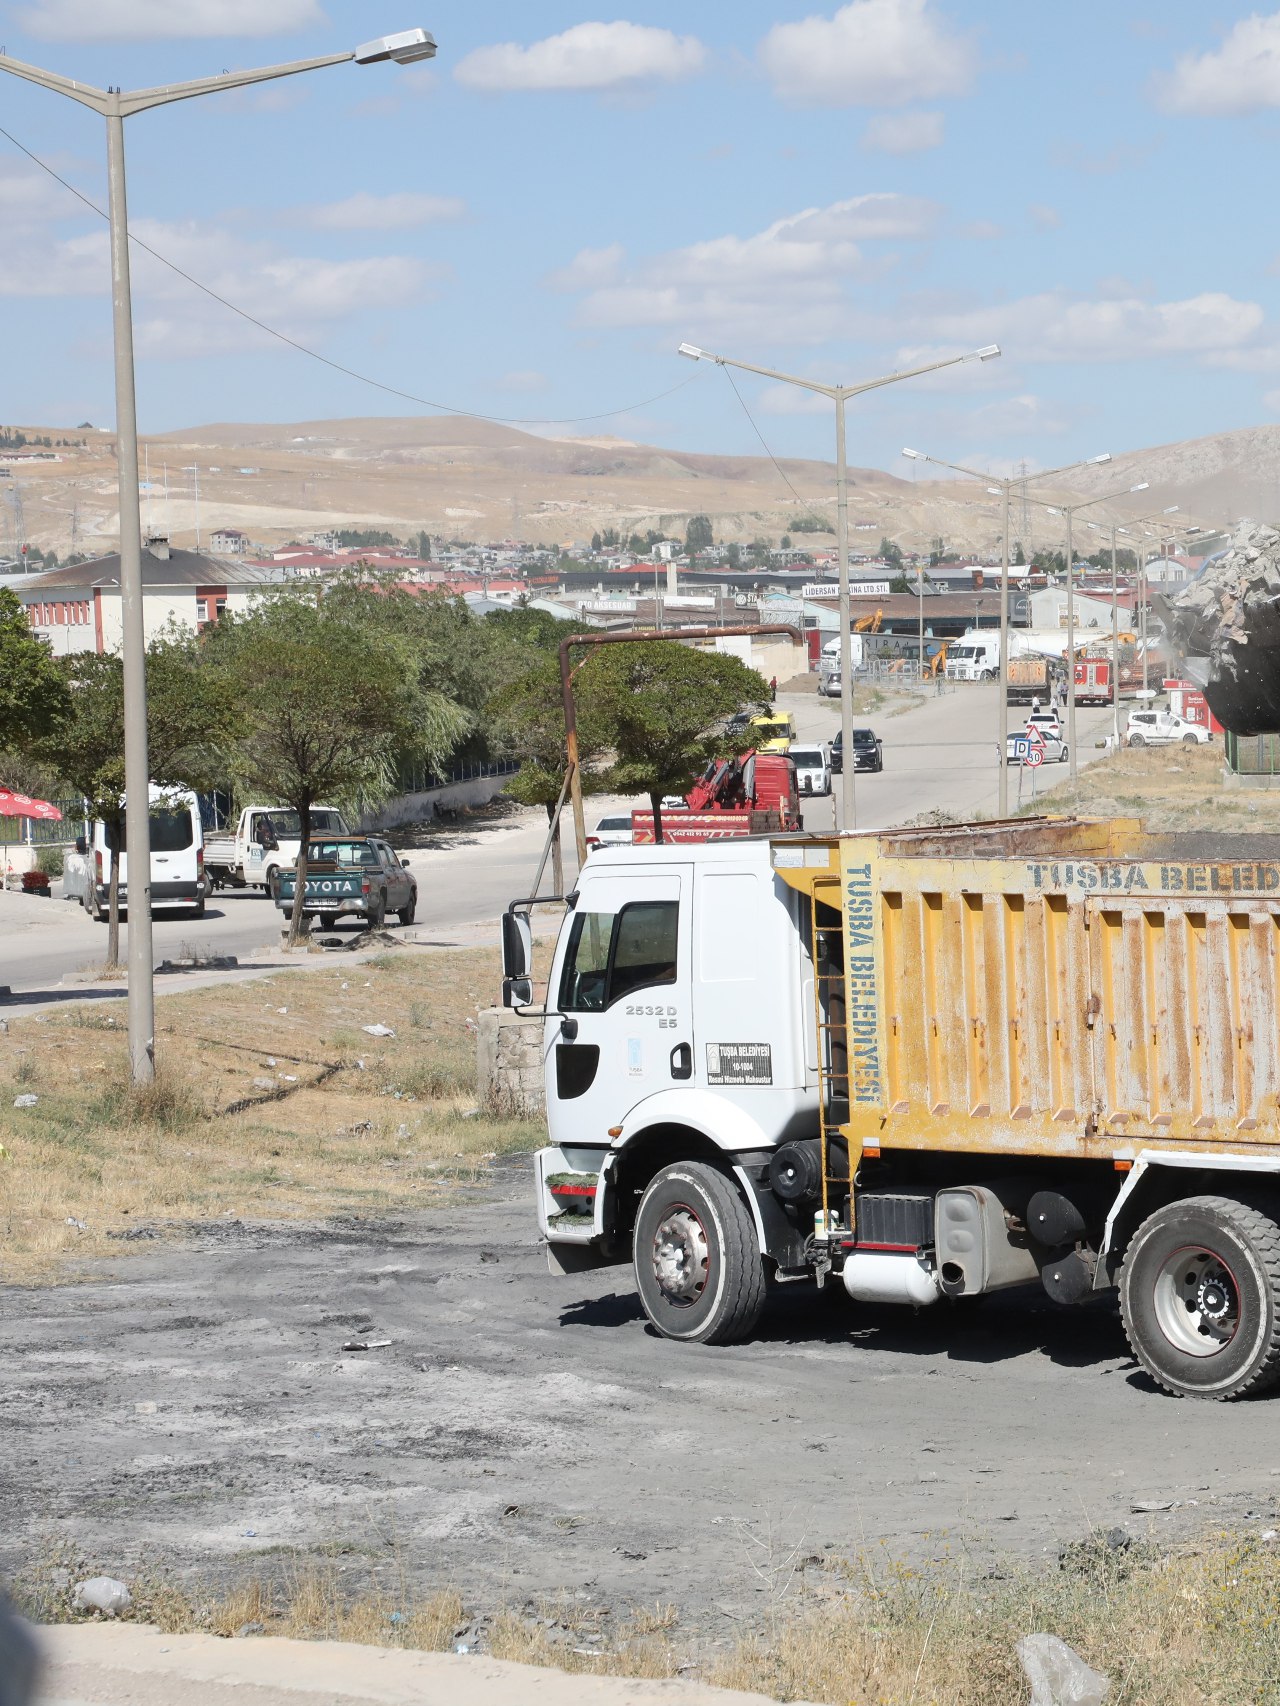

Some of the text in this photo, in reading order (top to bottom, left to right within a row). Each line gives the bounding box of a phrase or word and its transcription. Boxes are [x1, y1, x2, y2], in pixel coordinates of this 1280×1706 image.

[805, 586, 836, 596] LİDERSAN
[578, 600, 632, 610] OTO AKSESUAR
[1018, 742, 1026, 753] D
[1028, 753, 1040, 762] 30
[290, 880, 352, 892] TOYOTA
[625, 1005, 677, 1016] 2532 D
[658, 1018, 678, 1029] E5
[738, 1044, 770, 1057] BELEDİYESİ
